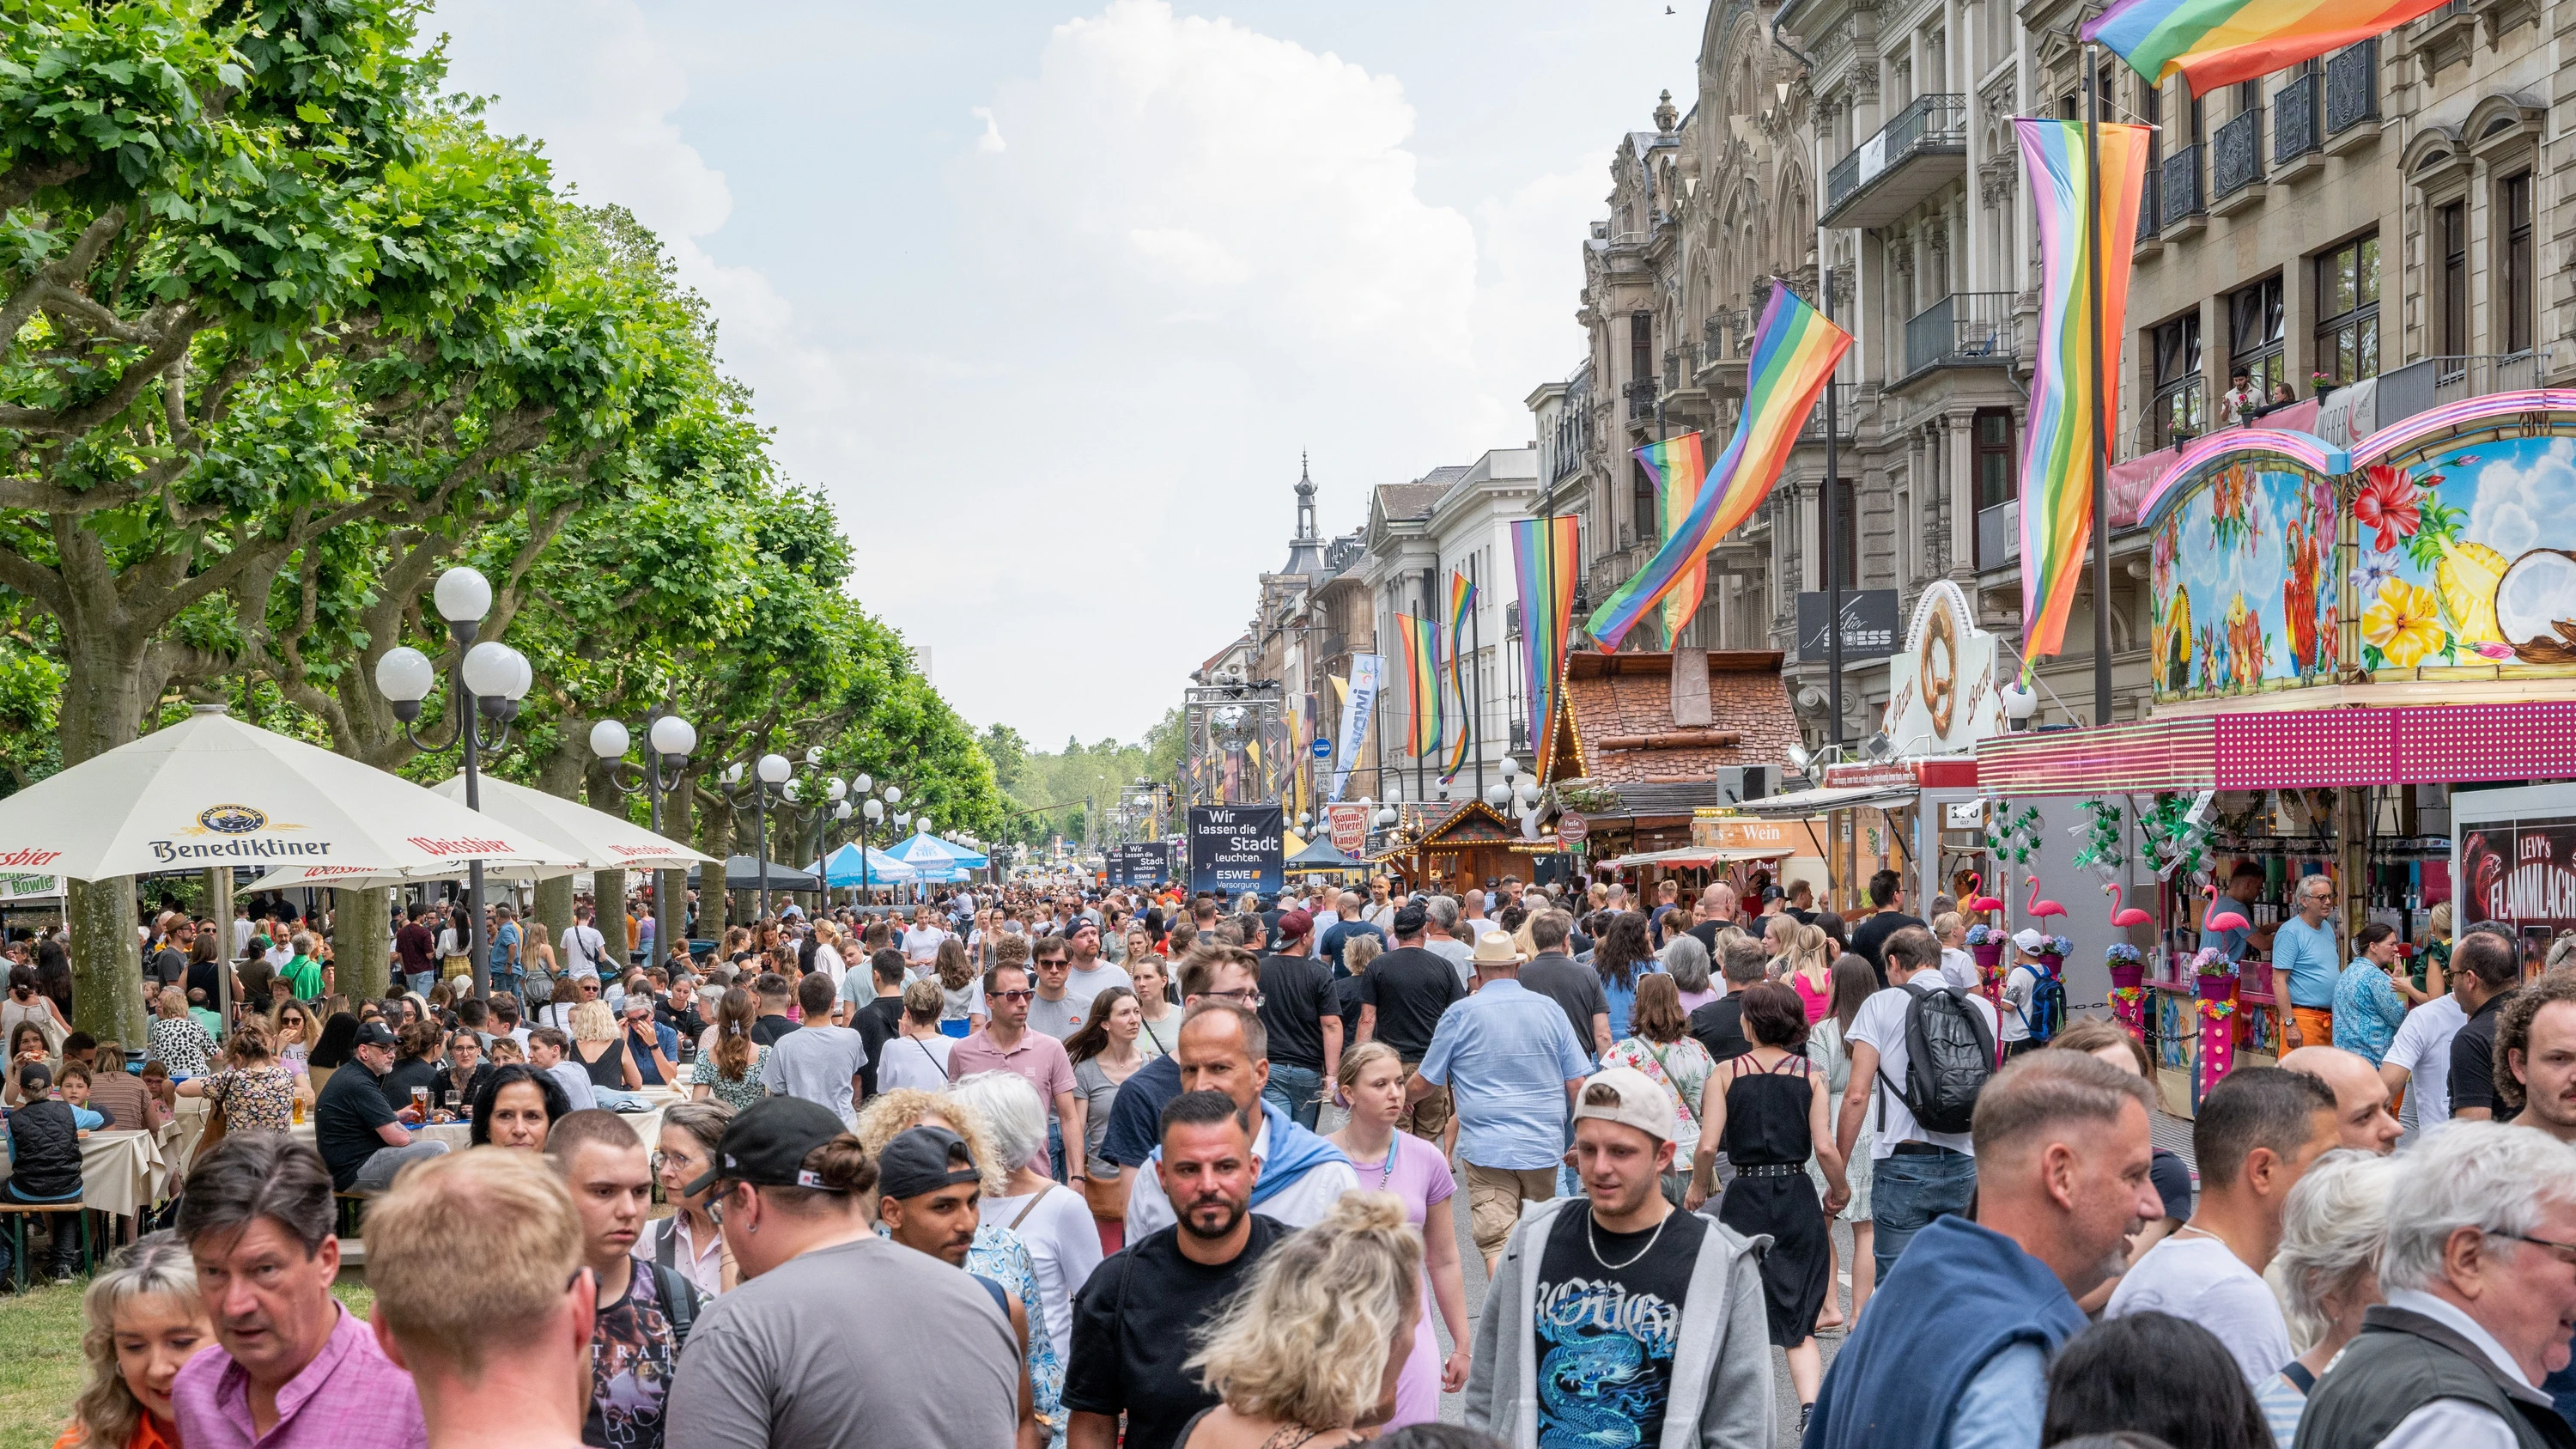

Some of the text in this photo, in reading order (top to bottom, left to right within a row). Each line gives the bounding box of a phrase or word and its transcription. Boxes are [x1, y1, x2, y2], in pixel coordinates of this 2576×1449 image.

[2318, 405, 2348, 446] WEBER
[1209, 810, 1236, 823] Wir
[1333, 813, 1363, 824] Baum-
[1199, 824, 1257, 835] lassen die
[1334, 820, 1363, 831] striezel
[1742, 825, 1780, 840] Wein
[407, 836, 515, 857] Weissbier
[1230, 836, 1279, 851] Stadt
[148, 838, 332, 863] Benediktiner
[1215, 853, 1262, 862] leuchten.
[1217, 870, 1250, 880] ESWE
[11, 876, 53, 894] Bowle
[1217, 880, 1260, 890] Versorgung
[280, 1050, 308, 1060] GUES
